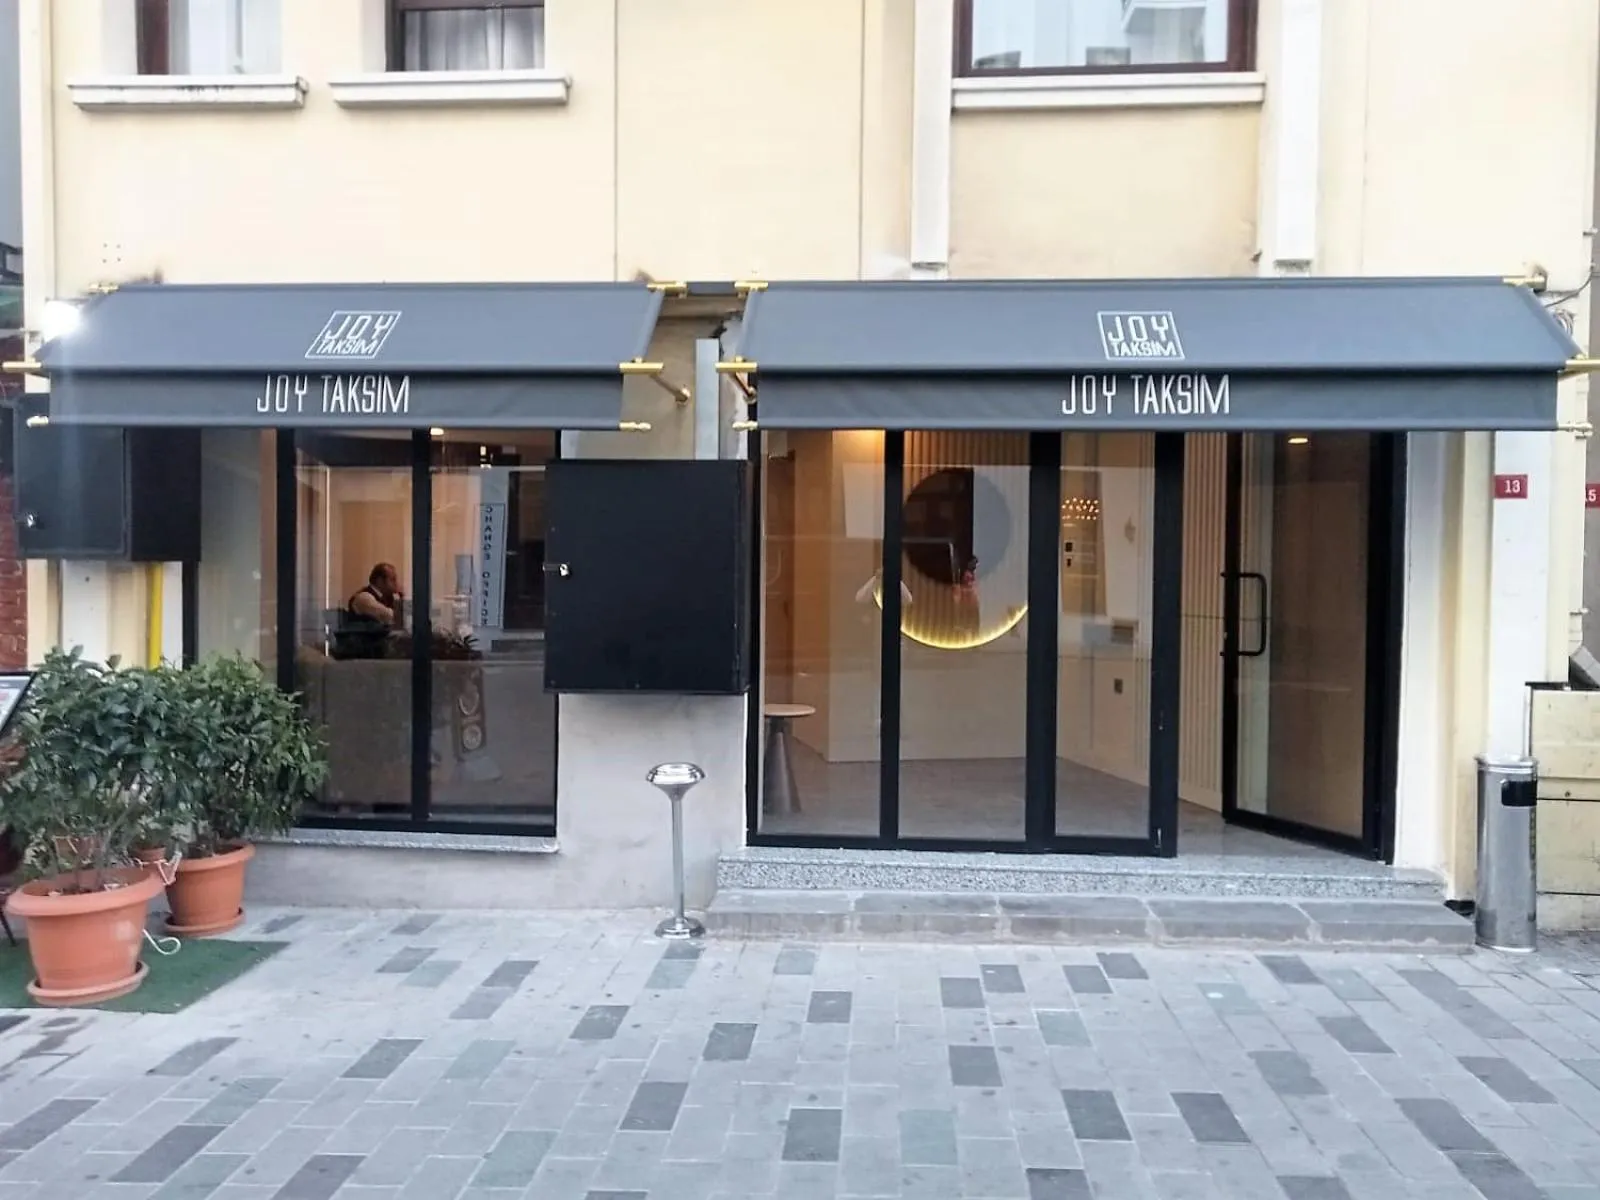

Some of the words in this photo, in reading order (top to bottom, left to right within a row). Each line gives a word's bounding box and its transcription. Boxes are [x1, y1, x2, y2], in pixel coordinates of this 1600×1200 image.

[325, 314, 393, 340] JOY
[1107, 315, 1169, 342] JOY
[256, 375, 308, 413] JOY
[1062, 375, 1116, 415] JOY
[1504, 479, 1521, 494] 13
